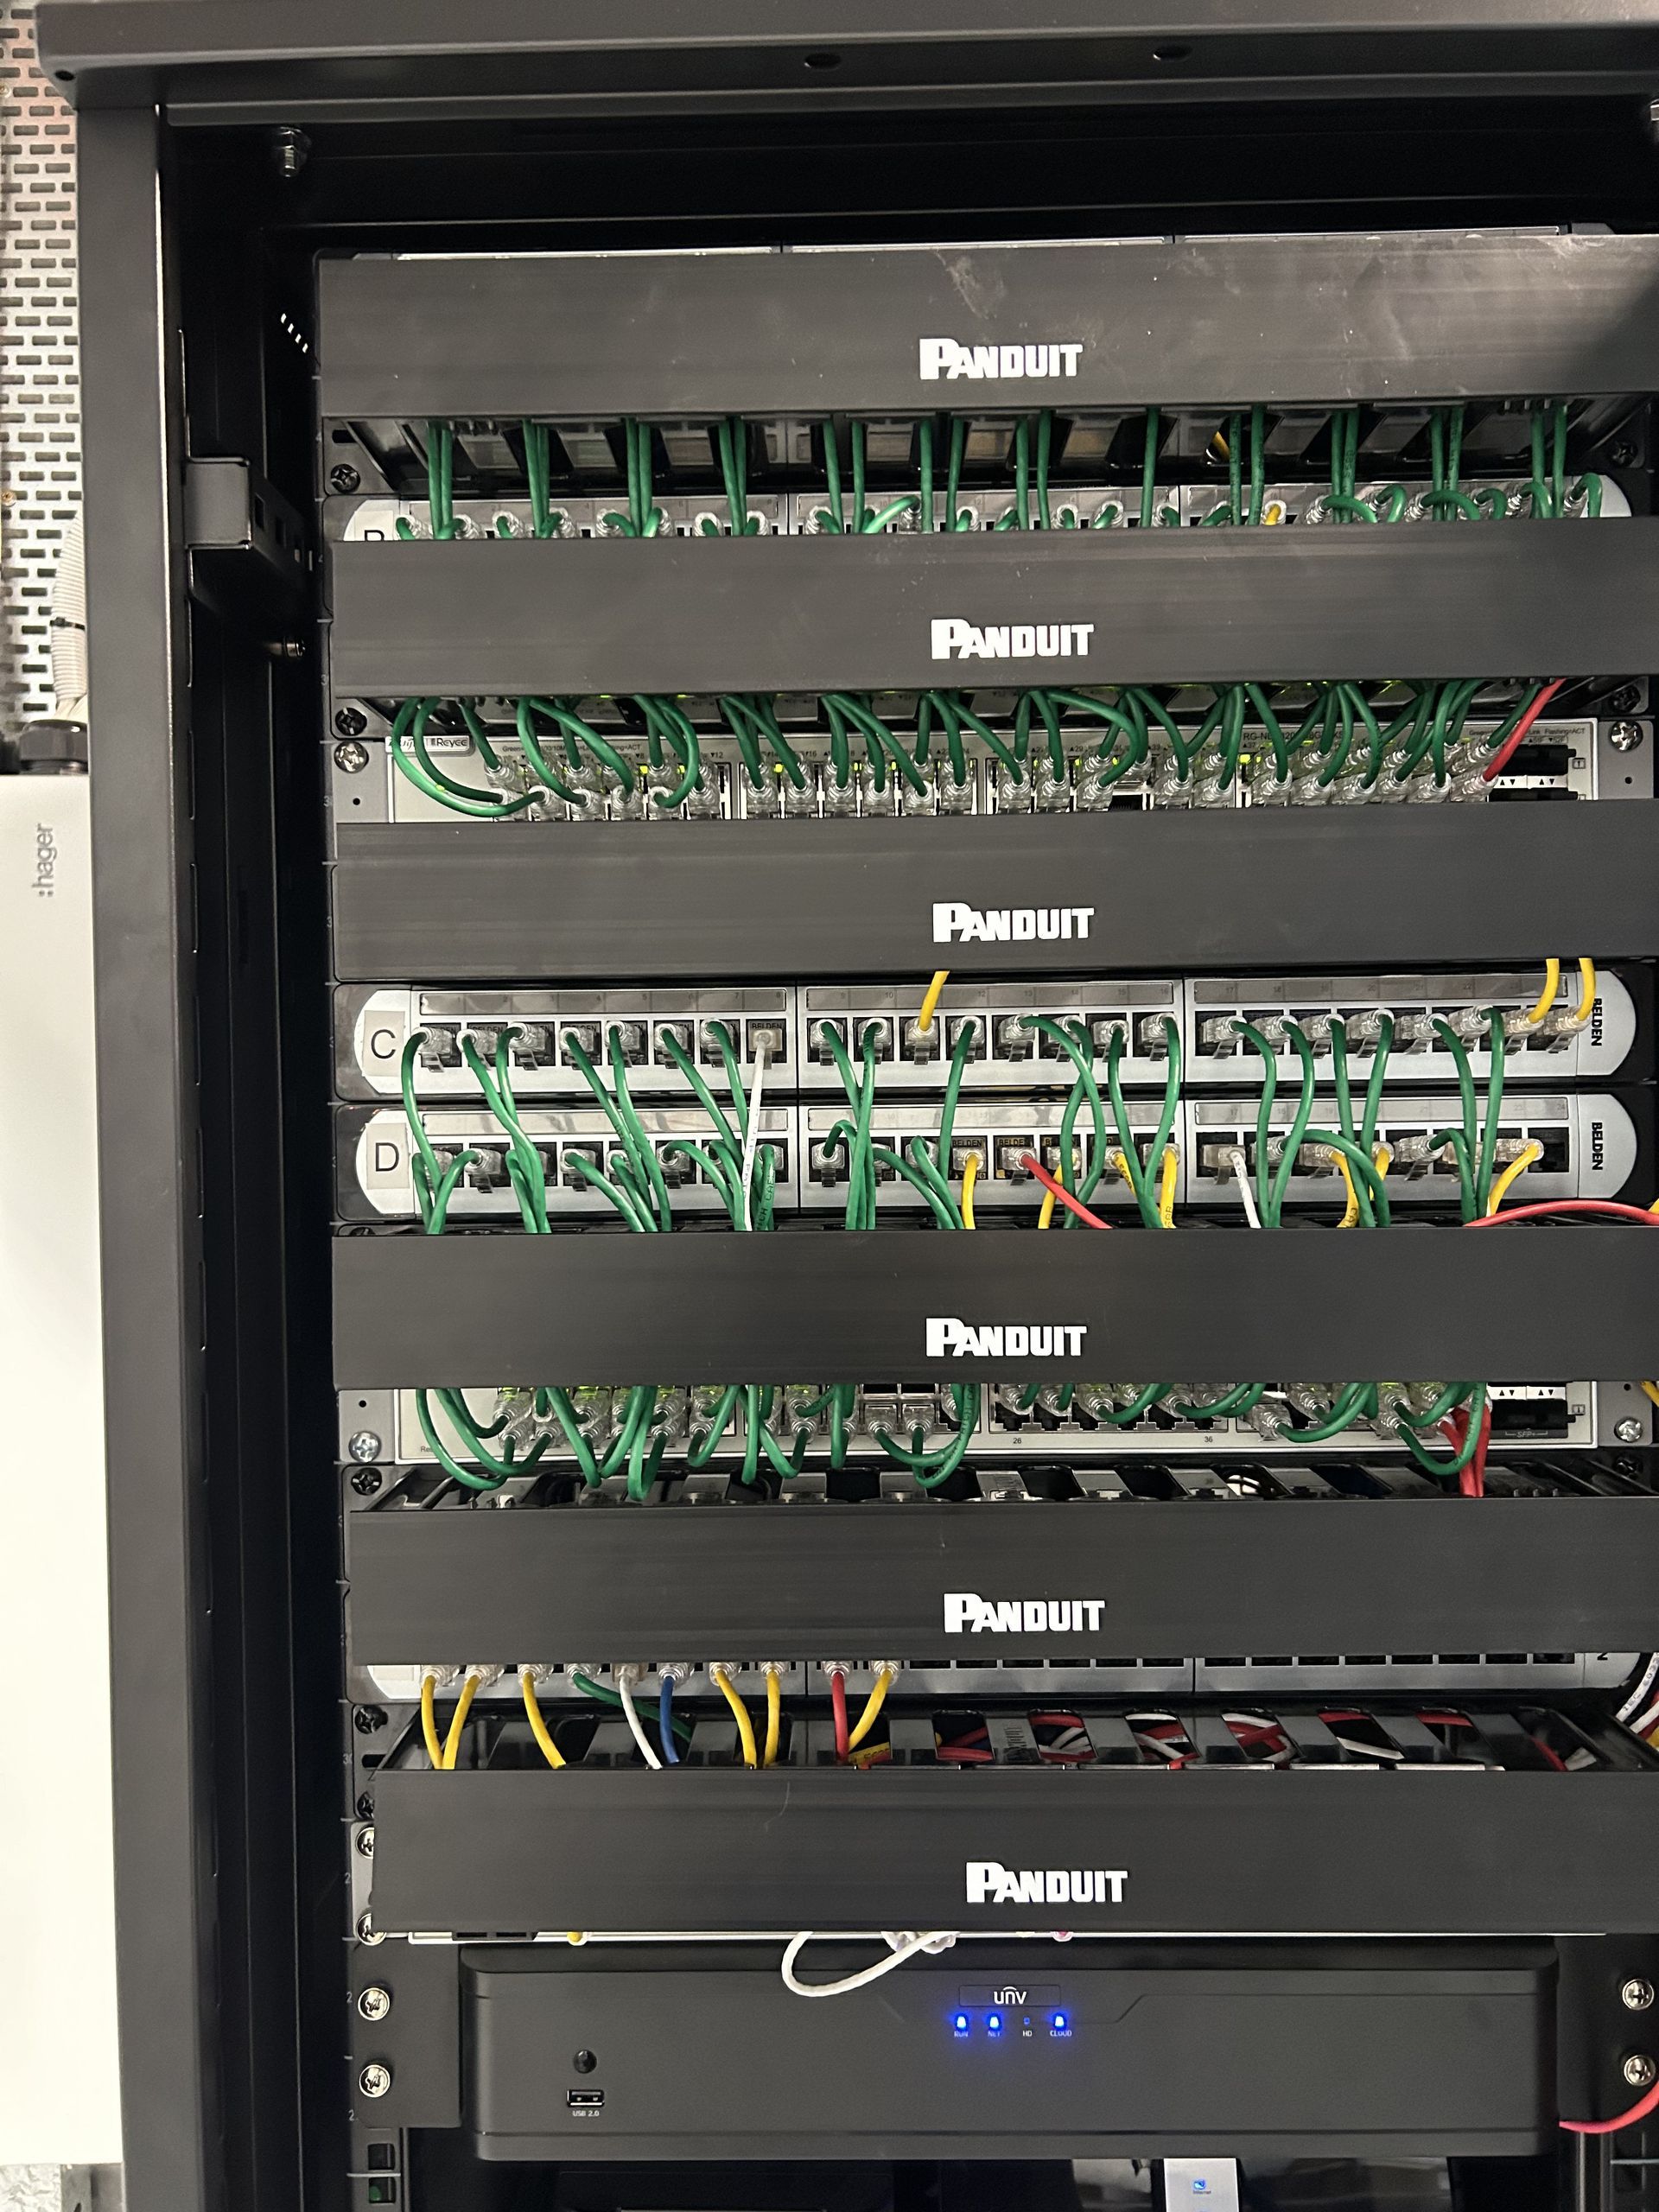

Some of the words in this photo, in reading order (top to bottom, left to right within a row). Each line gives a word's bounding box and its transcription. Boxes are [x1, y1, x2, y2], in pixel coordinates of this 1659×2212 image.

[919, 338, 1084, 380] PANDUIT
[931, 619, 1095, 660] PANDUIT
[932, 902, 1095, 943] PANDUIT
[371, 1028, 397, 1059] C
[375, 1142, 399, 1173] D
[1591, 1122, 1603, 1171] BELDEN
[925, 1318, 1087, 1357] PANDUIT
[944, 1592, 1105, 1633] PANDUIT
[966, 1861, 1128, 1904] PANDUIT
[994, 1986, 1027, 2005] unv
